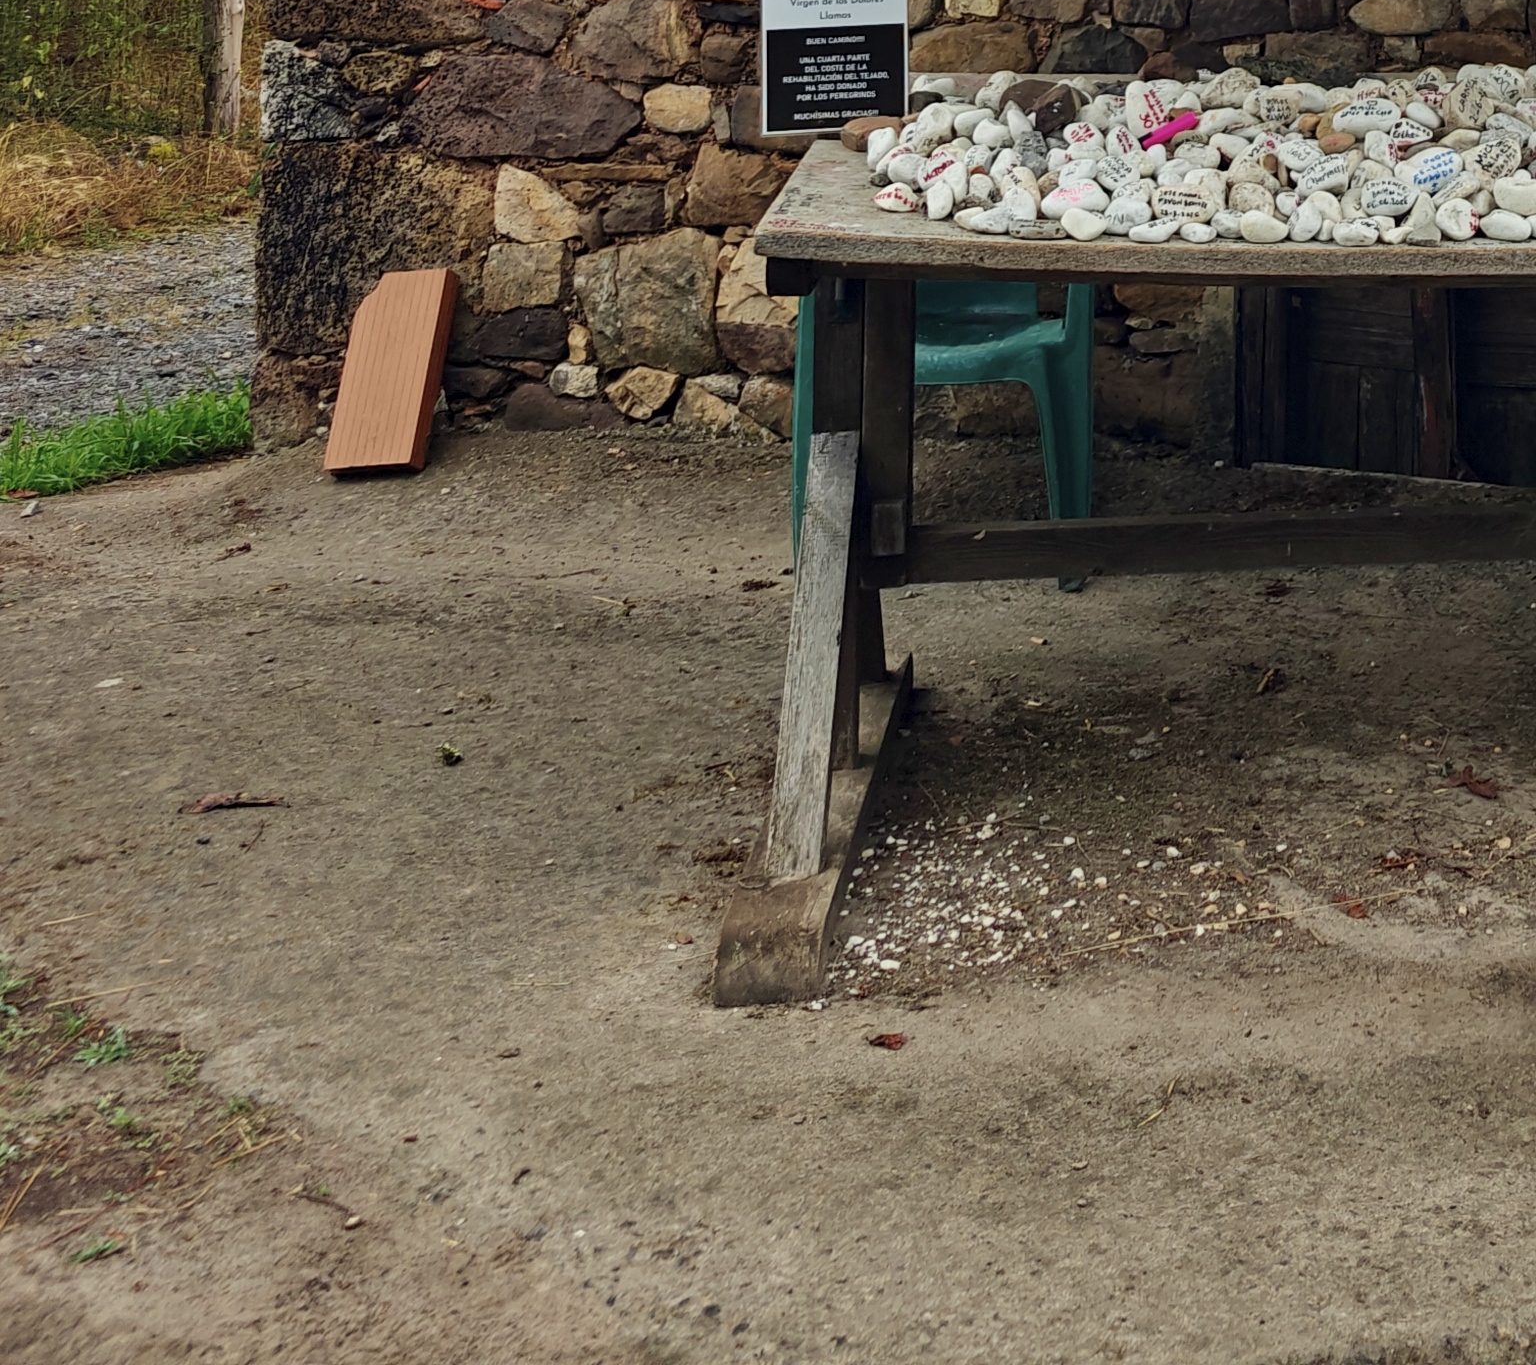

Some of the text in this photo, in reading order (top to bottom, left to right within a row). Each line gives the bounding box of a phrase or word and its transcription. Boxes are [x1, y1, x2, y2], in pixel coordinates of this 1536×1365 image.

[819, 11, 852, 20] Llamas
[806, 37, 827, 46] BUEN
[799, 53, 871, 64] UNA CUARTA PARTE
[804, 63, 868, 74] DEL COSTE DE LA
[844, 72, 859, 80] DEL
[805, 81, 868, 92] HA SIDO DONADO
[796, 90, 877, 102] POR LOS PEREGRINOS
[1139, 113, 1154, 129] 30
